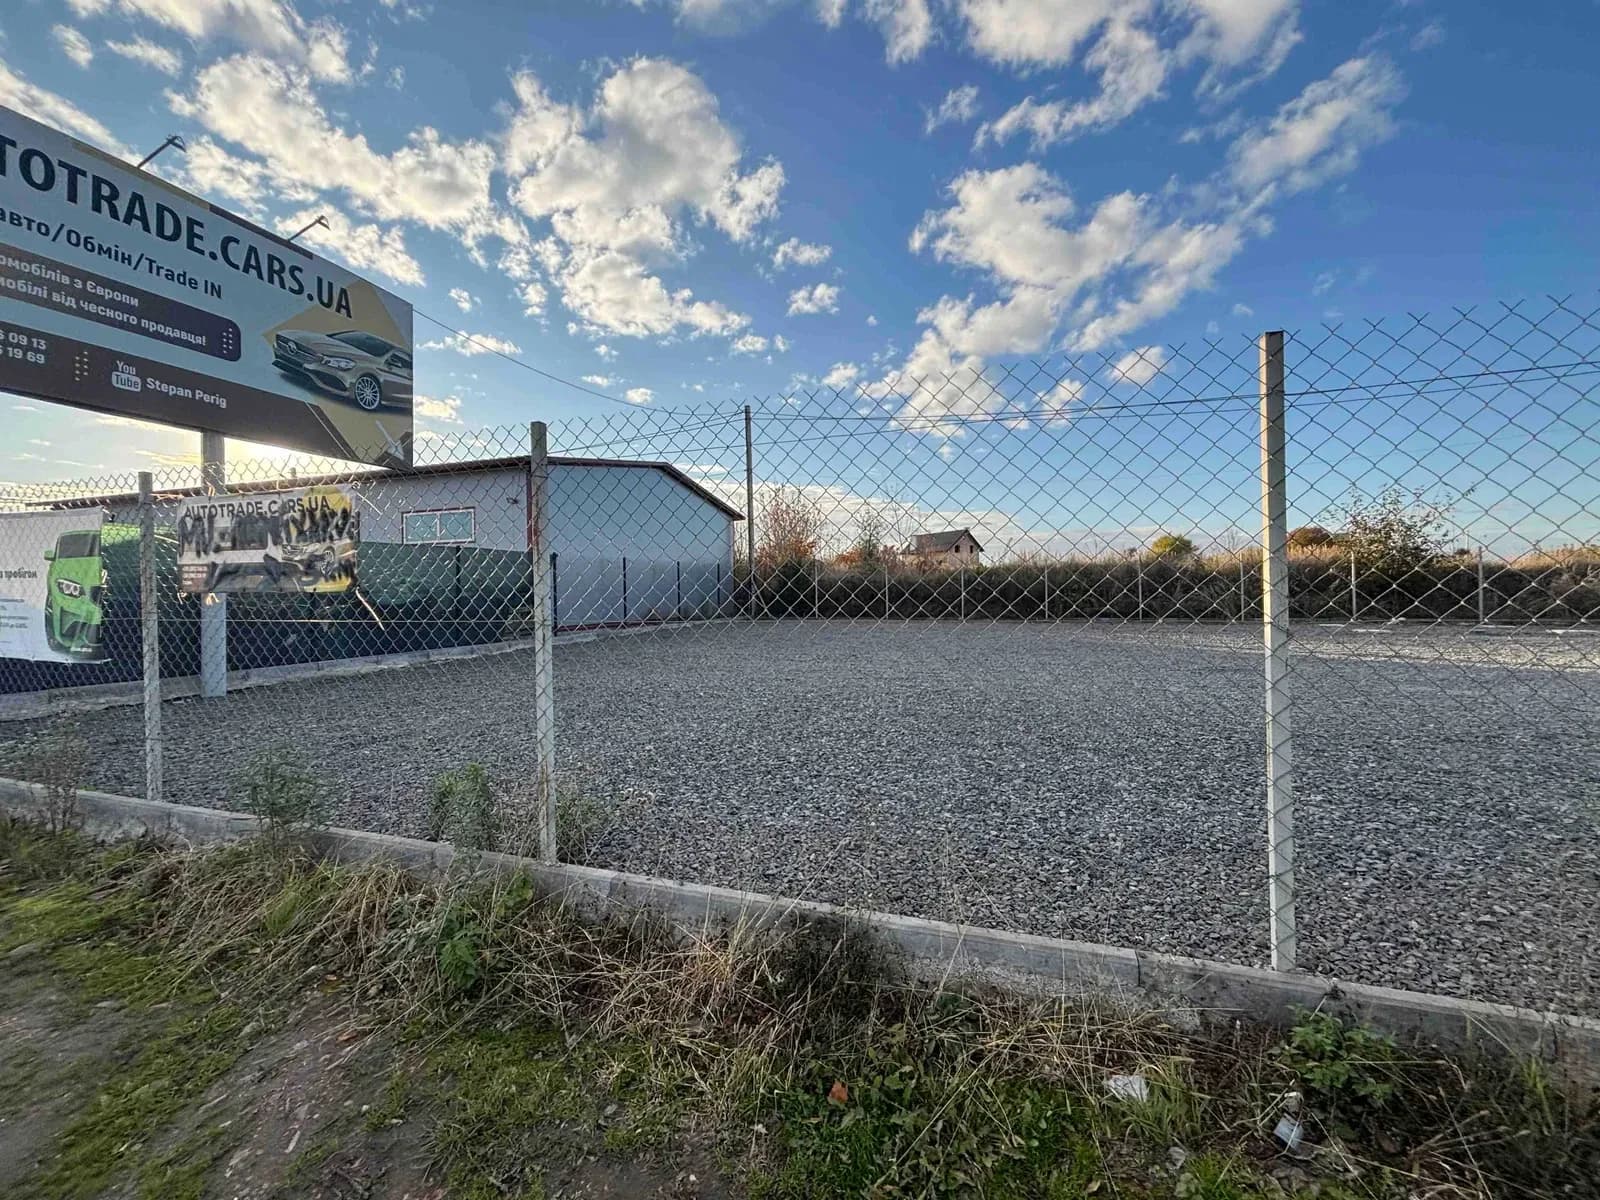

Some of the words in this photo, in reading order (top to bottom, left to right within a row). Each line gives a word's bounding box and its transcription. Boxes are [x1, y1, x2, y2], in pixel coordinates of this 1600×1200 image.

[87, 281, 139, 308] Європи
[204, 279, 223, 300] IN
[52, 291, 77, 309] від
[80, 300, 138, 325] чесного
[141, 319, 207, 346] продавця!
[8, 332, 28, 346] 09
[31, 338, 47, 350] 13
[7, 347, 23, 359] 19
[27, 351, 45, 364] 69
[116, 360, 137, 376] You
[114, 373, 140, 390] Tube
[146, 378, 192, 399] Stepan
[195, 389, 227, 409] Perig
